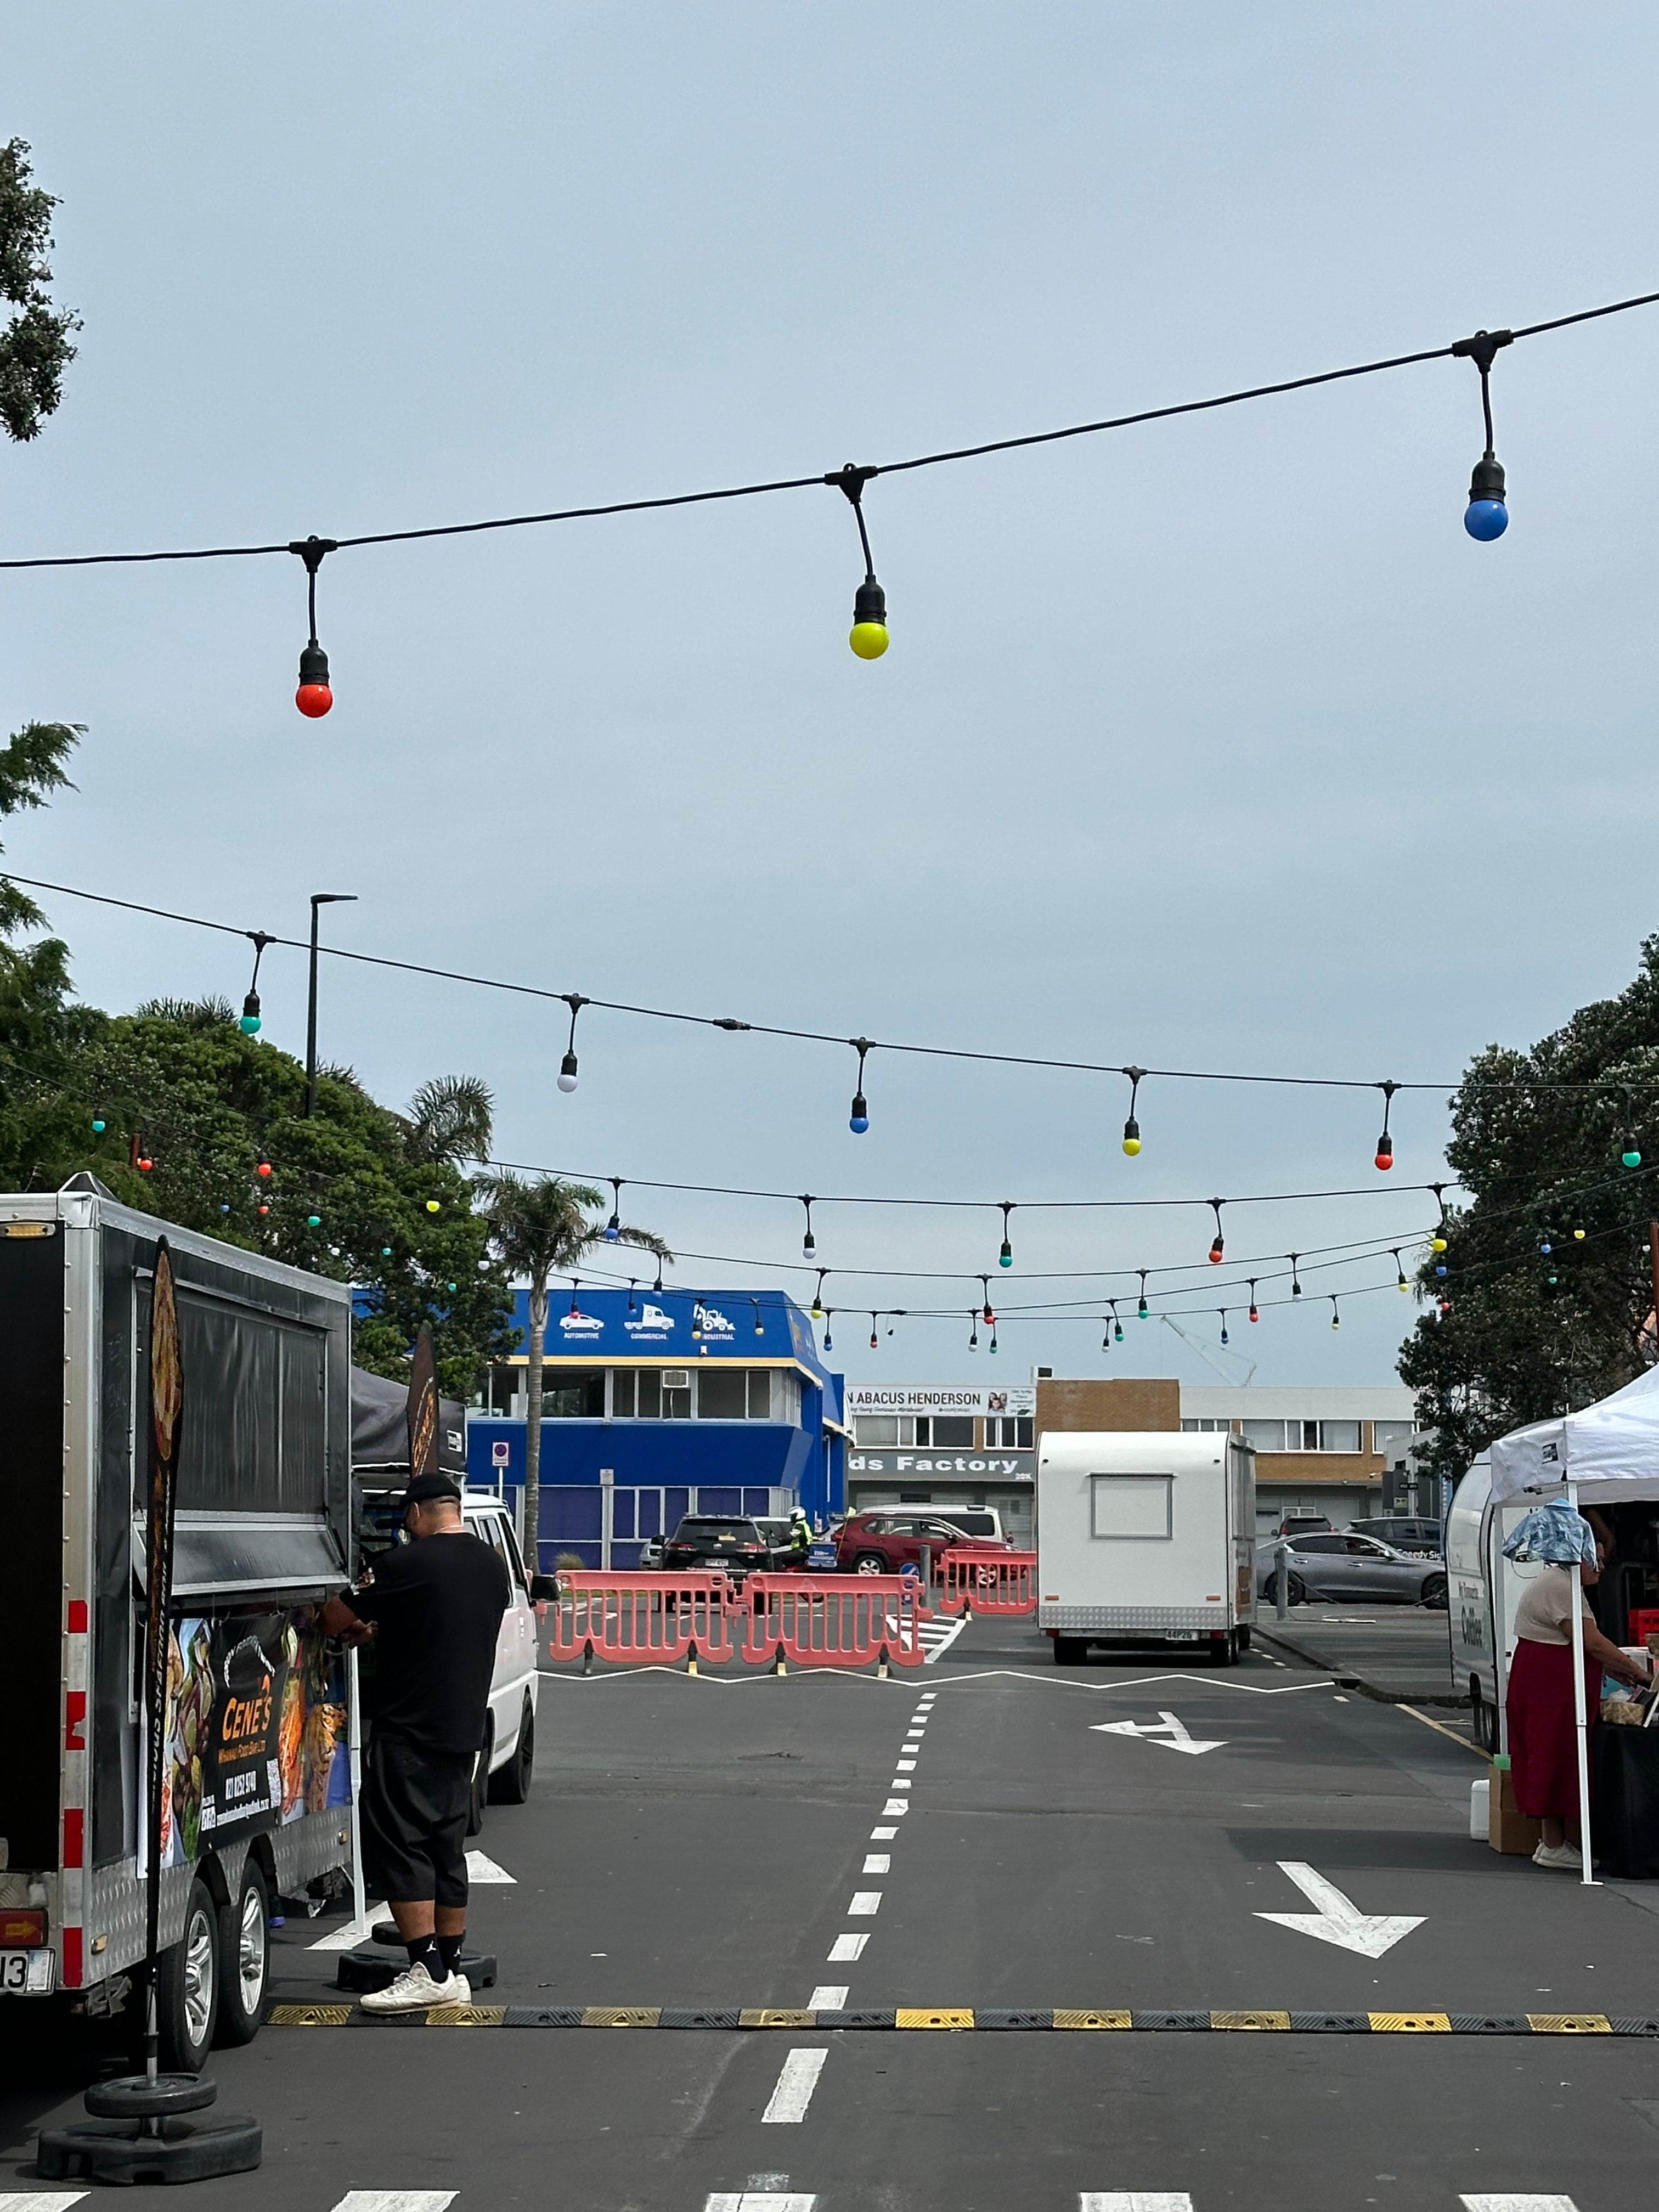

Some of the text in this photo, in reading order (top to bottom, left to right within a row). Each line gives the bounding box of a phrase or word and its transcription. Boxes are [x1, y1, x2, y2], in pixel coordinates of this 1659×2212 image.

[856, 1392, 905, 1404] ABACUS
[908, 1392, 980, 1405] HENDERSON
[897, 1455, 1018, 1474] Factory
